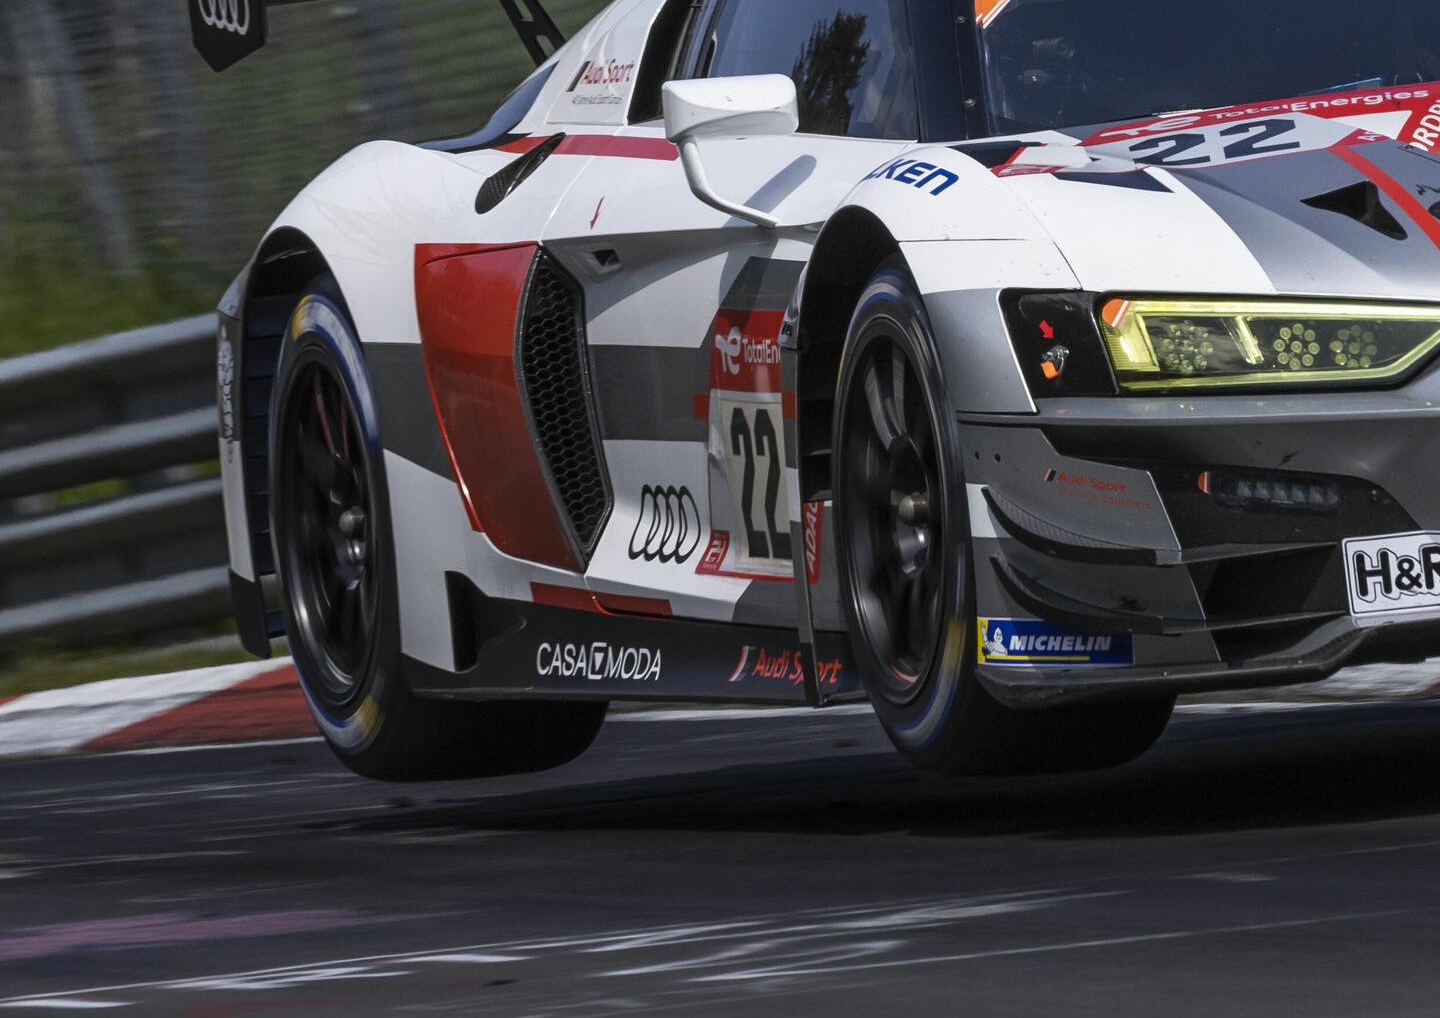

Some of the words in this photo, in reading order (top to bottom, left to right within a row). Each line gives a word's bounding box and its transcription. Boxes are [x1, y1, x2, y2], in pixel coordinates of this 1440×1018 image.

[1128, 118, 1301, 166] 22
[729, 407, 793, 561] 22
[1058, 471, 1087, 487] Audi
[1089, 477, 1126, 495] Sport
[1009, 635, 1112, 651] MICHELIN
[751, 647, 790, 679] Audi
